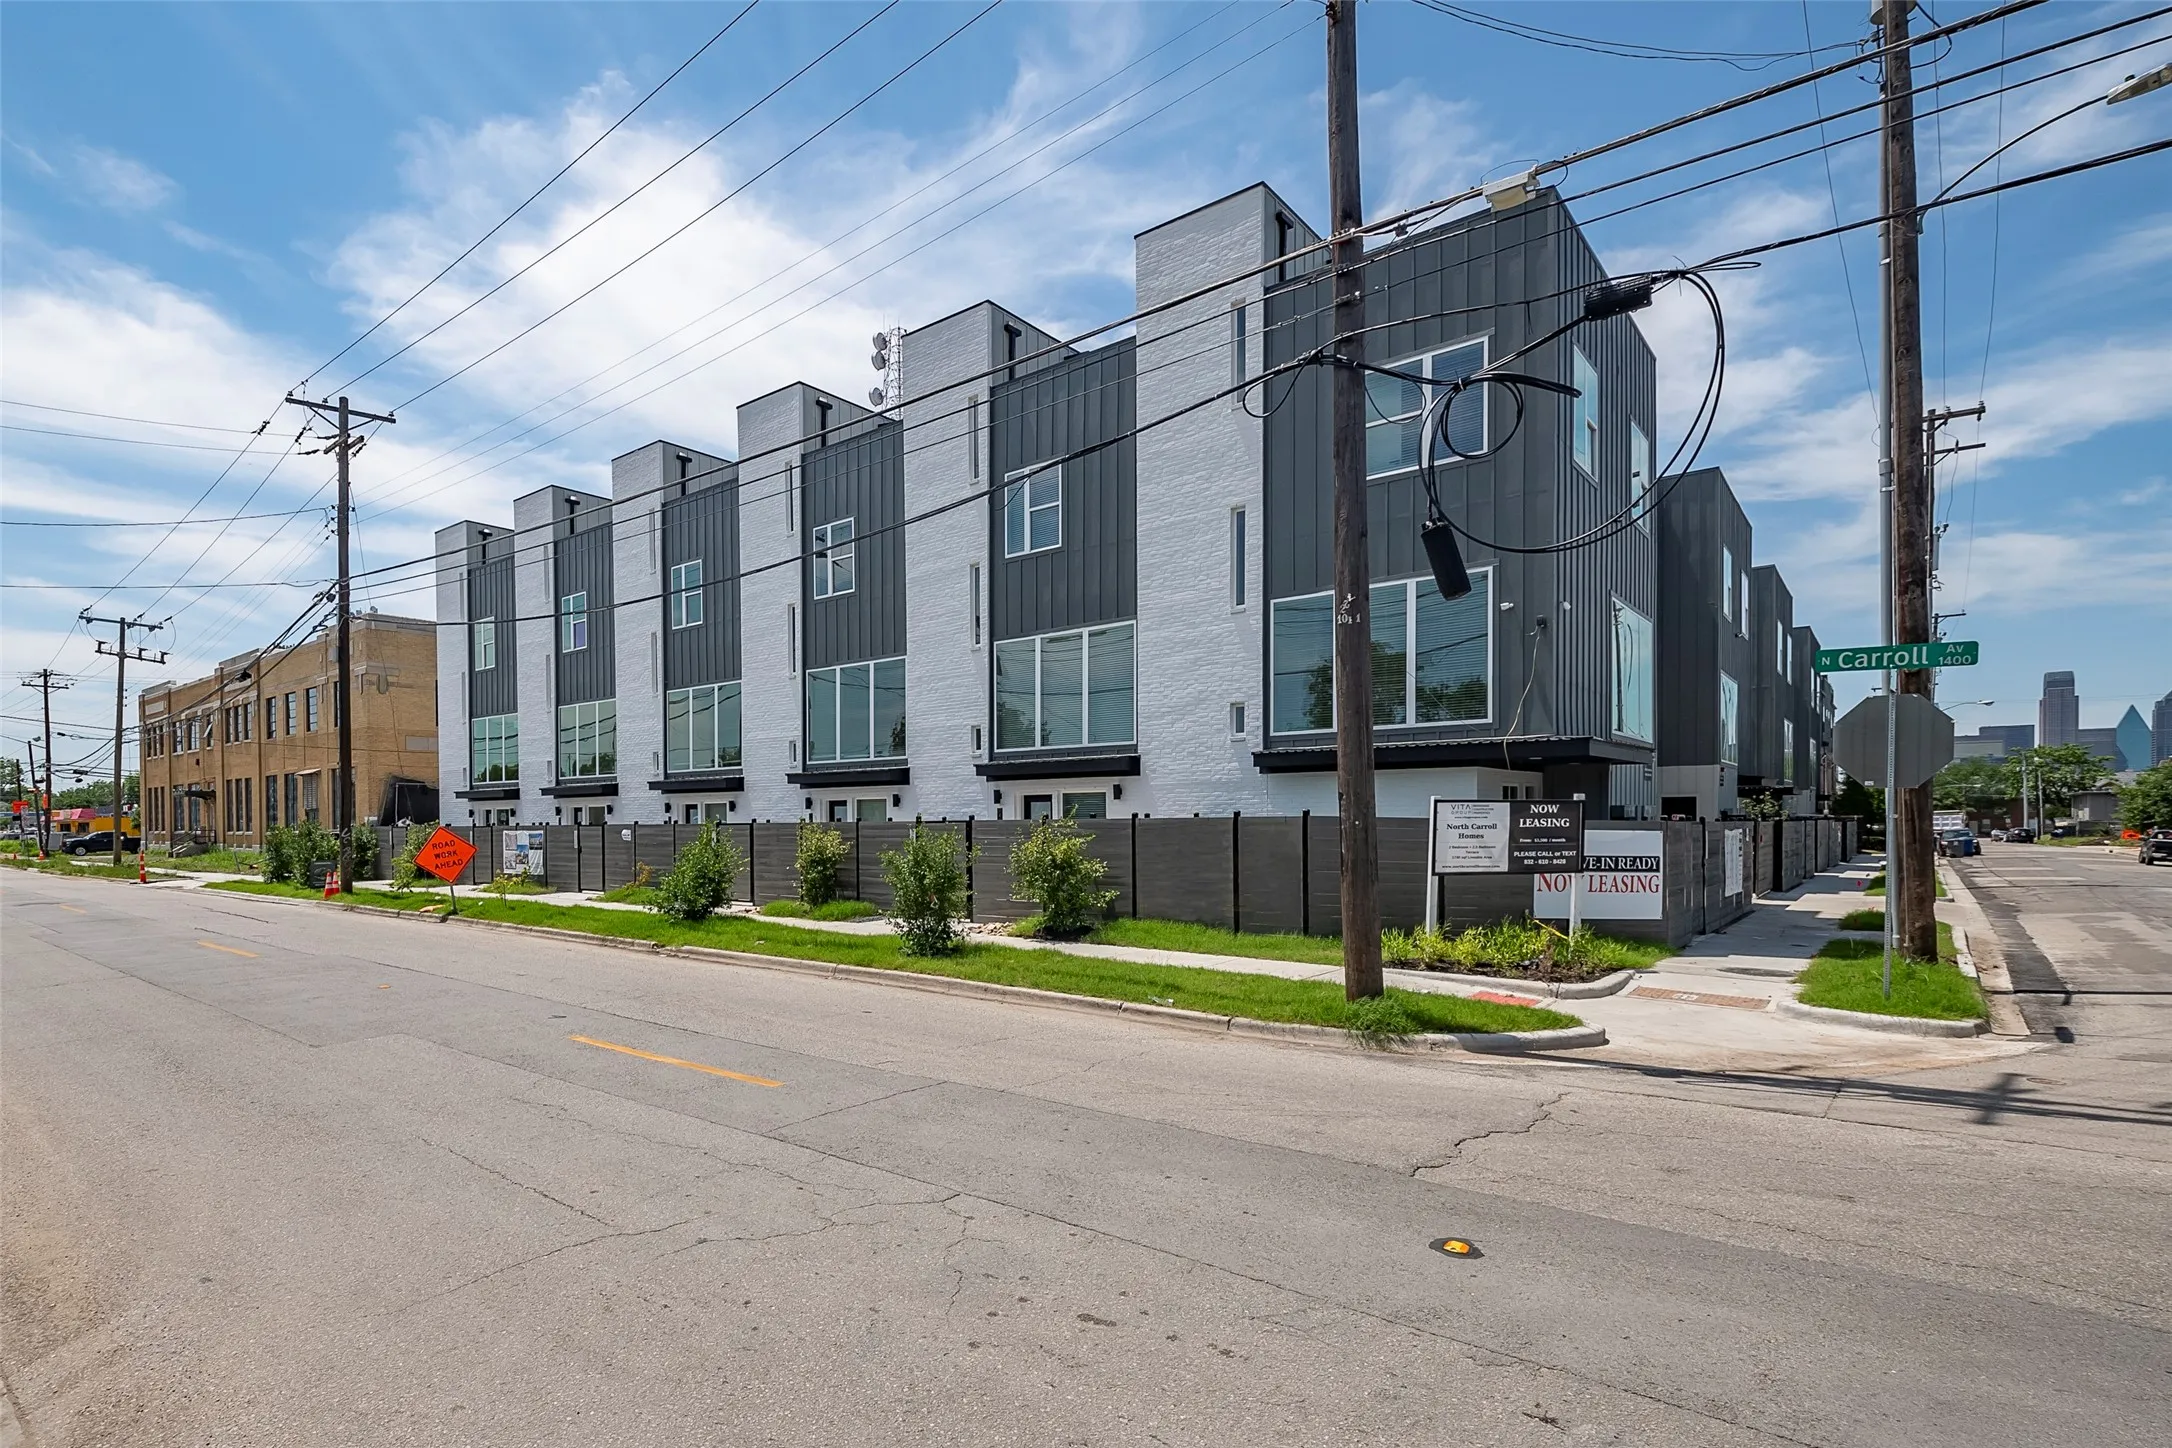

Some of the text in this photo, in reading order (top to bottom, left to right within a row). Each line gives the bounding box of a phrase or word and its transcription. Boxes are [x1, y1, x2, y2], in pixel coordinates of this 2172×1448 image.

[1821, 656, 1830, 666] N
[1838, 646, 1929, 668] Carroll
[1938, 655, 1972, 666] 1400
[1530, 804, 1559, 813] NOW
[1519, 818, 1569, 827] LEASING
[432, 840, 455, 850] ROAD
[434, 850, 458, 860] WORK
[435, 859, 463, 870] AHEAD
[1583, 857, 1660, 869] VE-IN READY
[1588, 875, 1660, 893] LEASING
